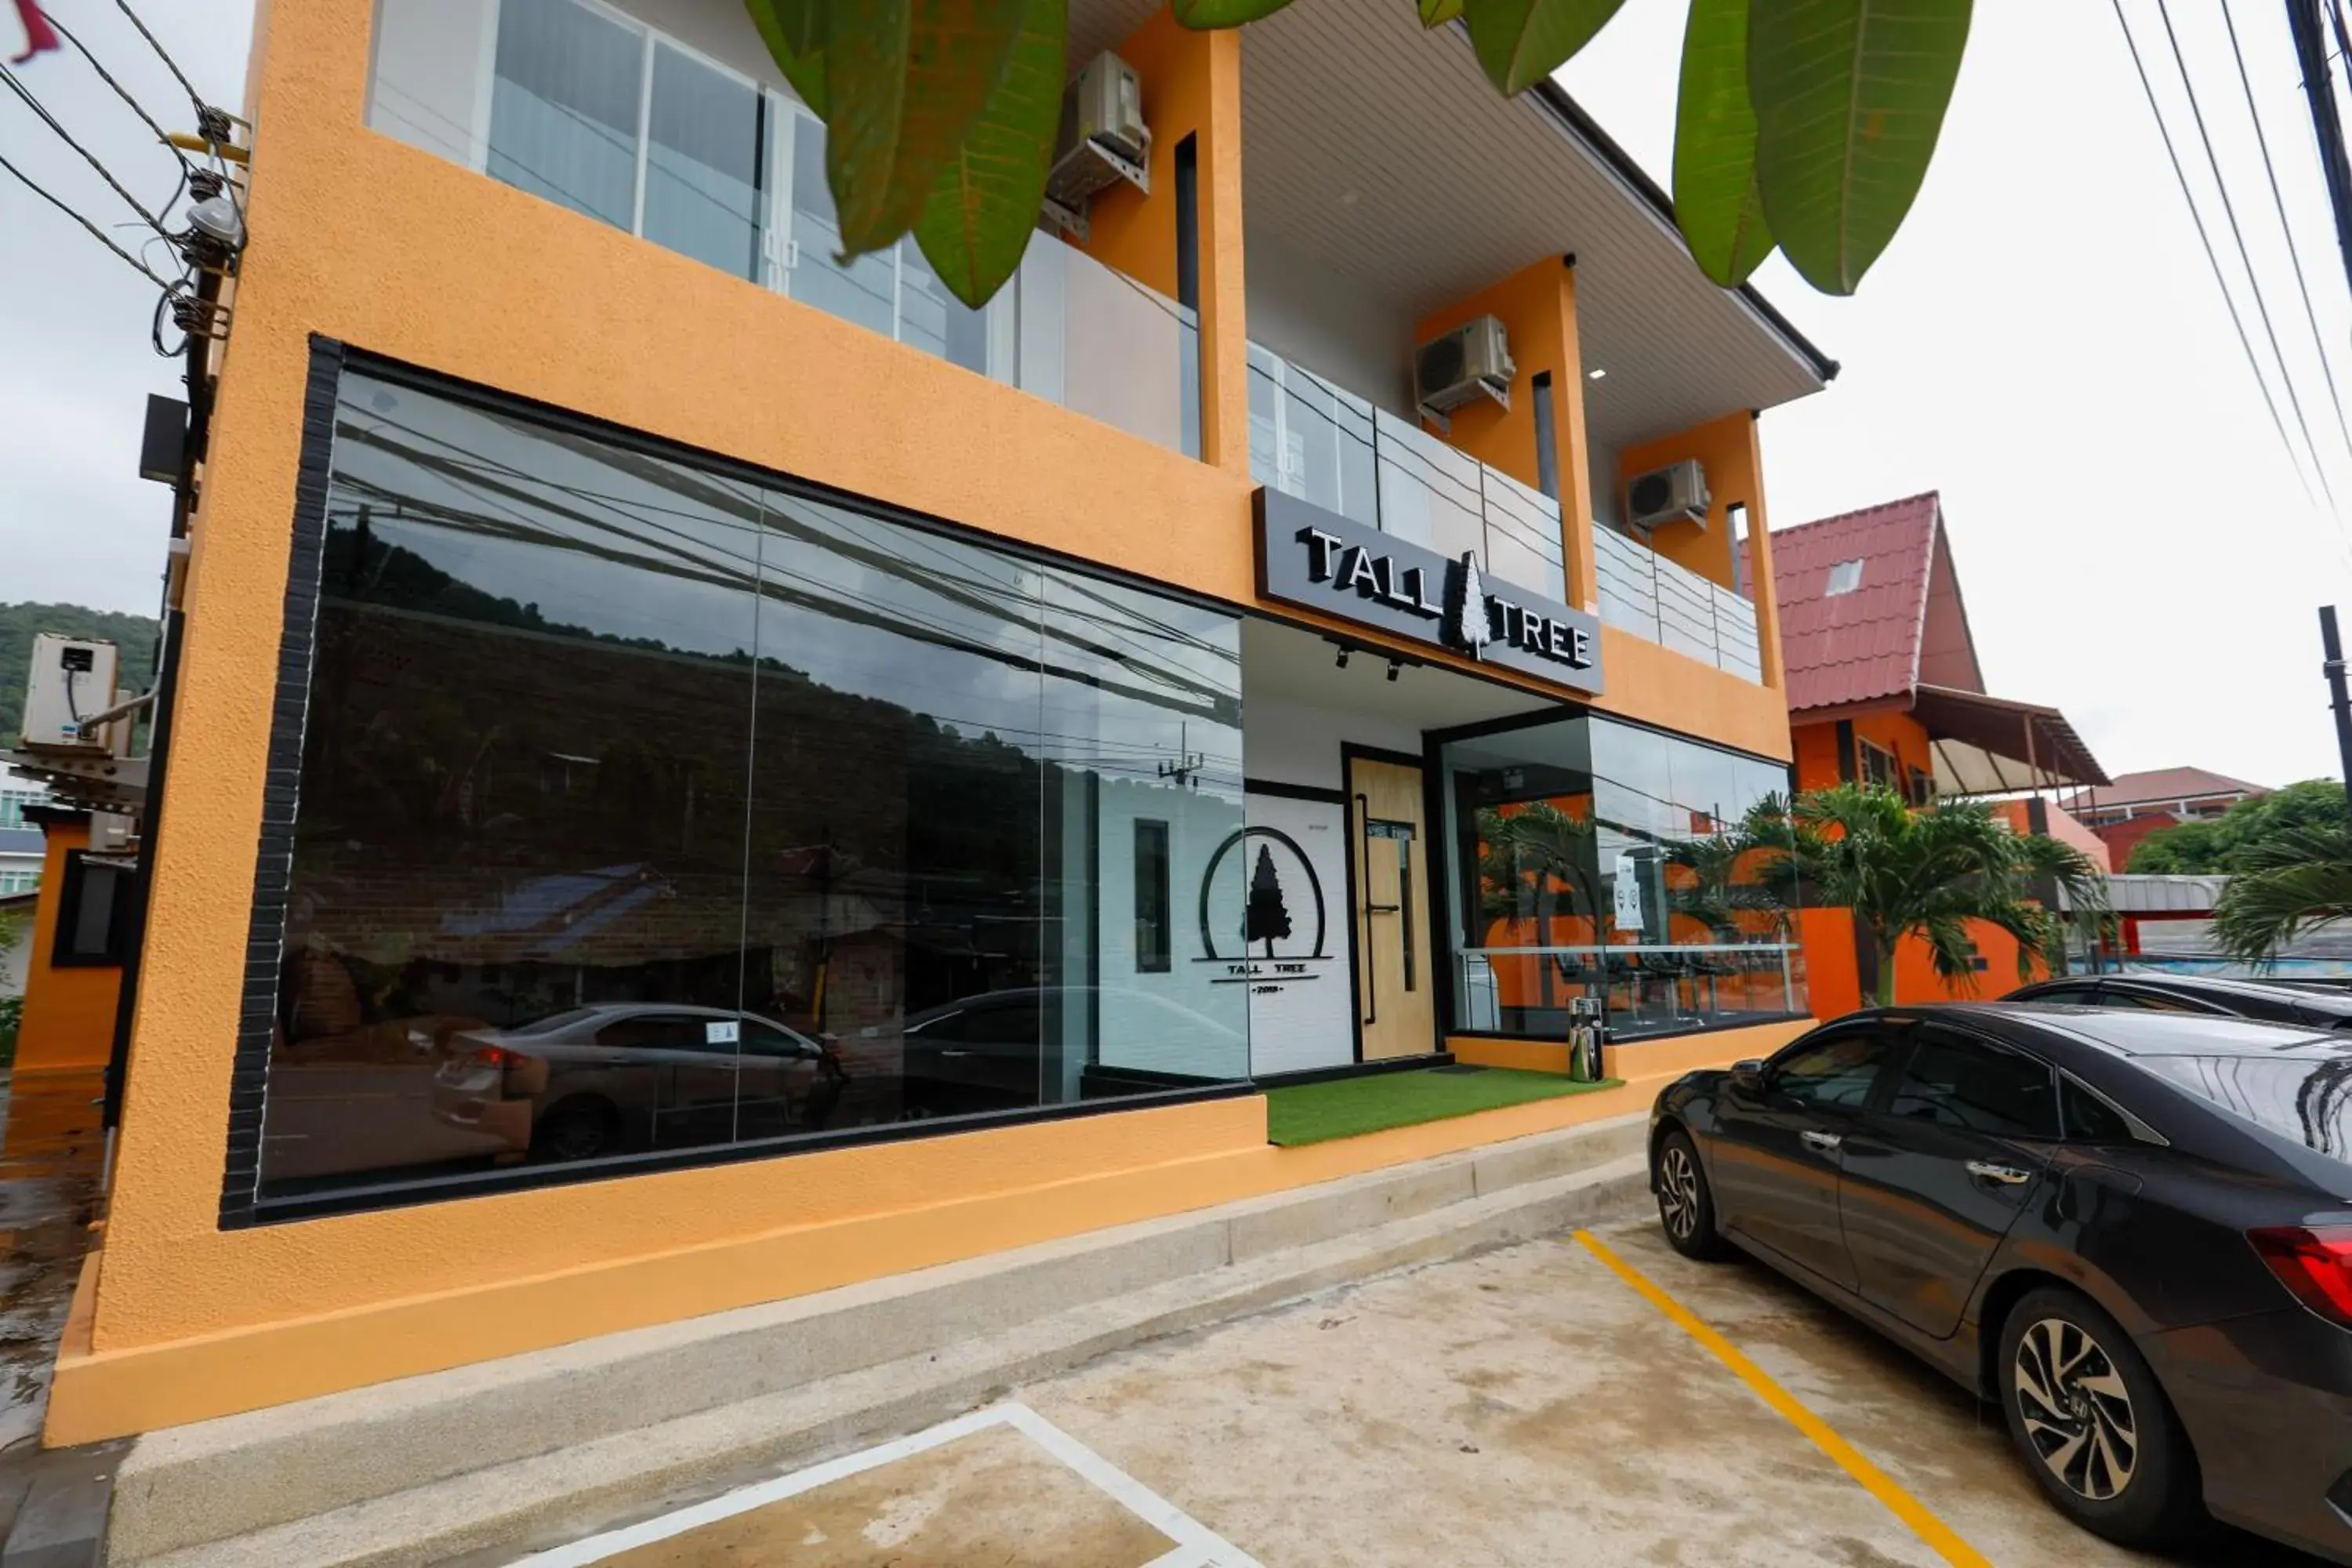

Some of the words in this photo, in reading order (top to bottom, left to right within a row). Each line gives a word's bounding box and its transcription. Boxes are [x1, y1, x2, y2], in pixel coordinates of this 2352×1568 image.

[1299, 526, 1444, 618] TALL
[1488, 595, 1592, 669] TREE
[1227, 964, 1263, 975] TALL
[1274, 964, 1307, 973] TREE
